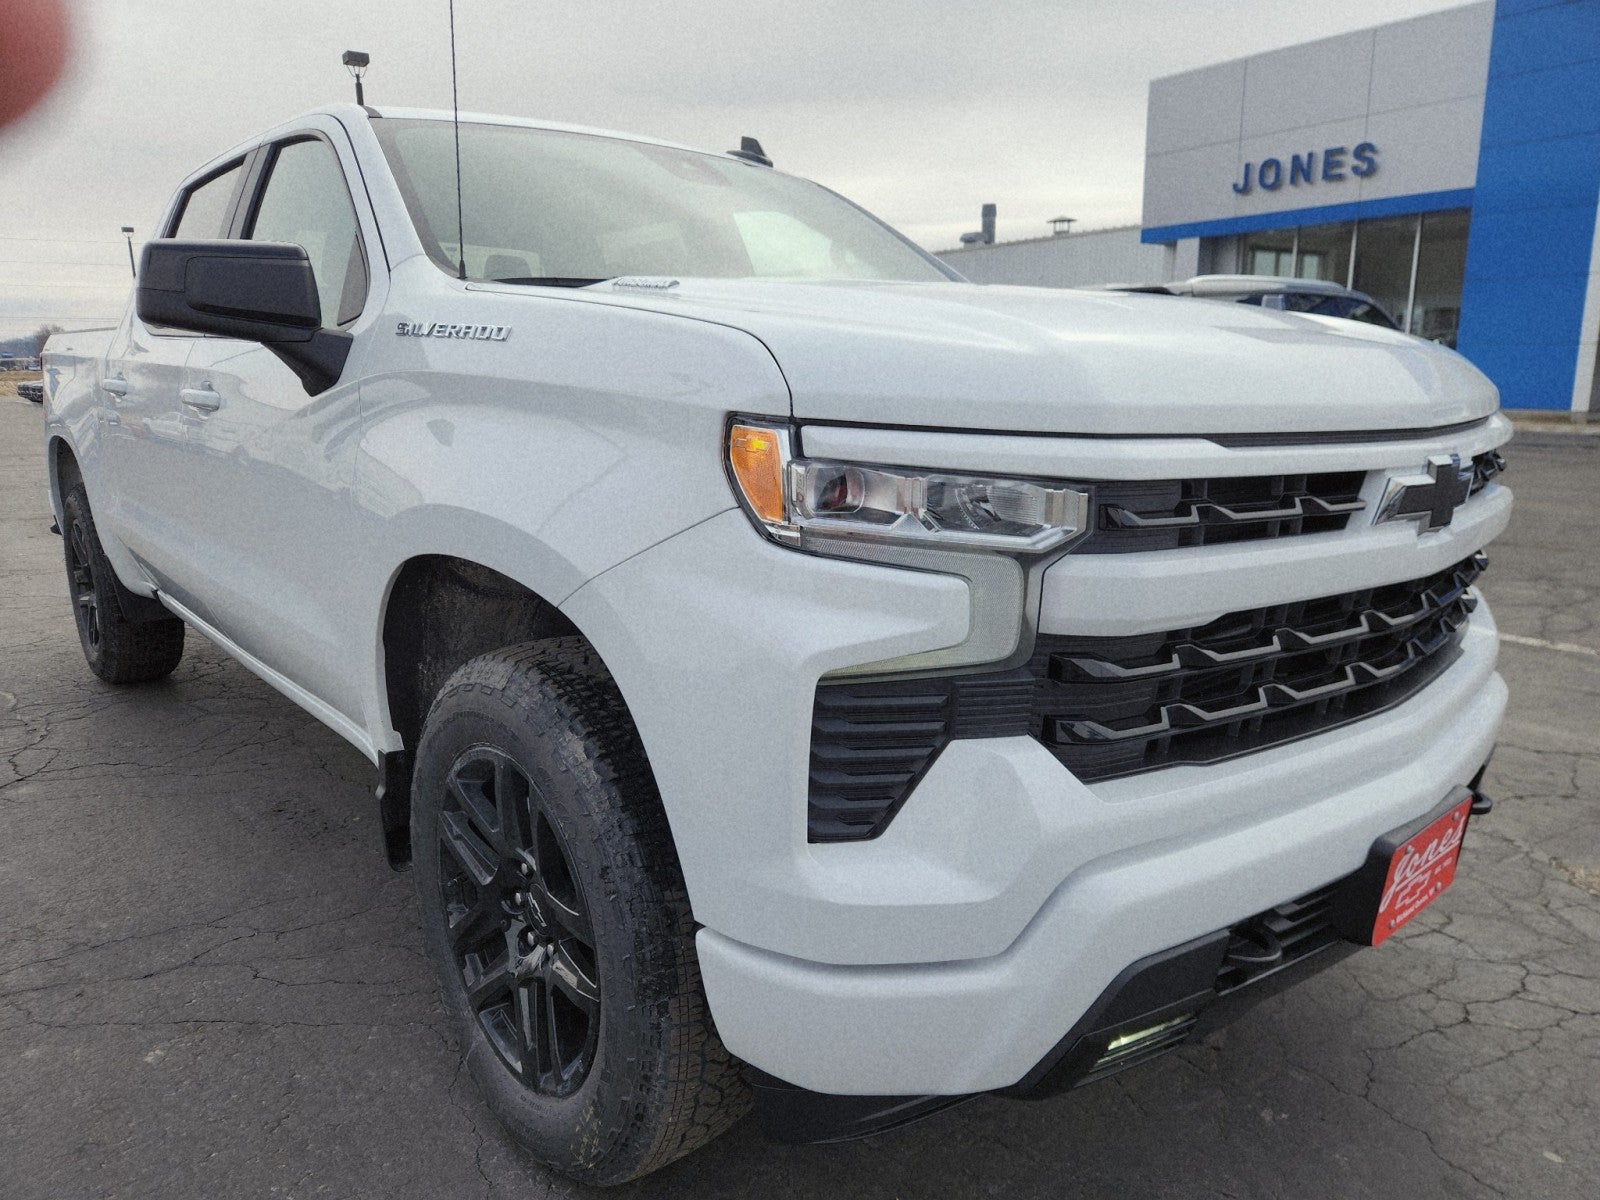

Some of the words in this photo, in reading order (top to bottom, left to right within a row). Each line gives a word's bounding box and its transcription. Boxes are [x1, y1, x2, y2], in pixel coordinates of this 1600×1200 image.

[1232, 142, 1377, 194] JONES
[395, 322, 512, 341] SILVERADO
[1378, 815, 1467, 914] Jones
